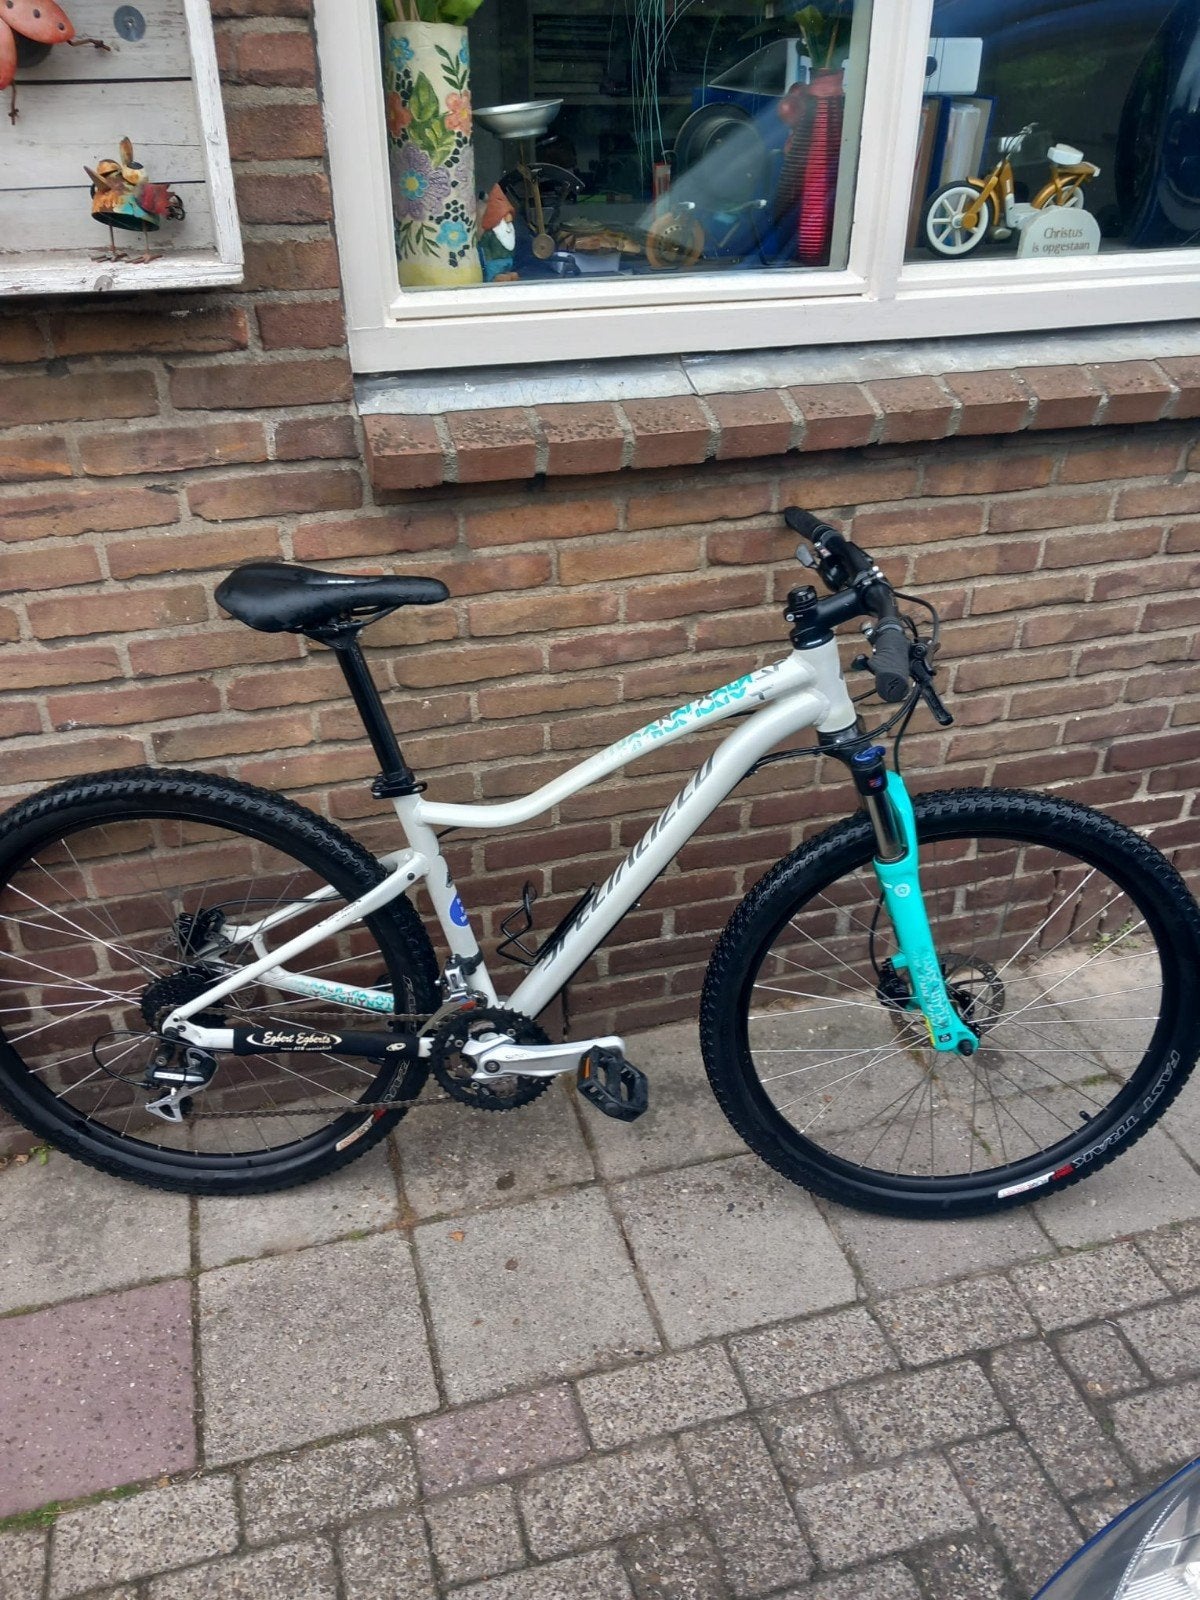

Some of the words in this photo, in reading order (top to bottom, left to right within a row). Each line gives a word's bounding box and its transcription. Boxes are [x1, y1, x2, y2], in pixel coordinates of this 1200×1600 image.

[1043, 226, 1084, 239] Christus
[1032, 242, 1039, 252] is
[1042, 242, 1090, 254] opgestaan
[262, 1031, 295, 1047] Egbert
[295, 1032, 331, 1047] Egberts
[1143, 1049, 1181, 1115] FAST
[1073, 1115, 1141, 1169] TRAK
